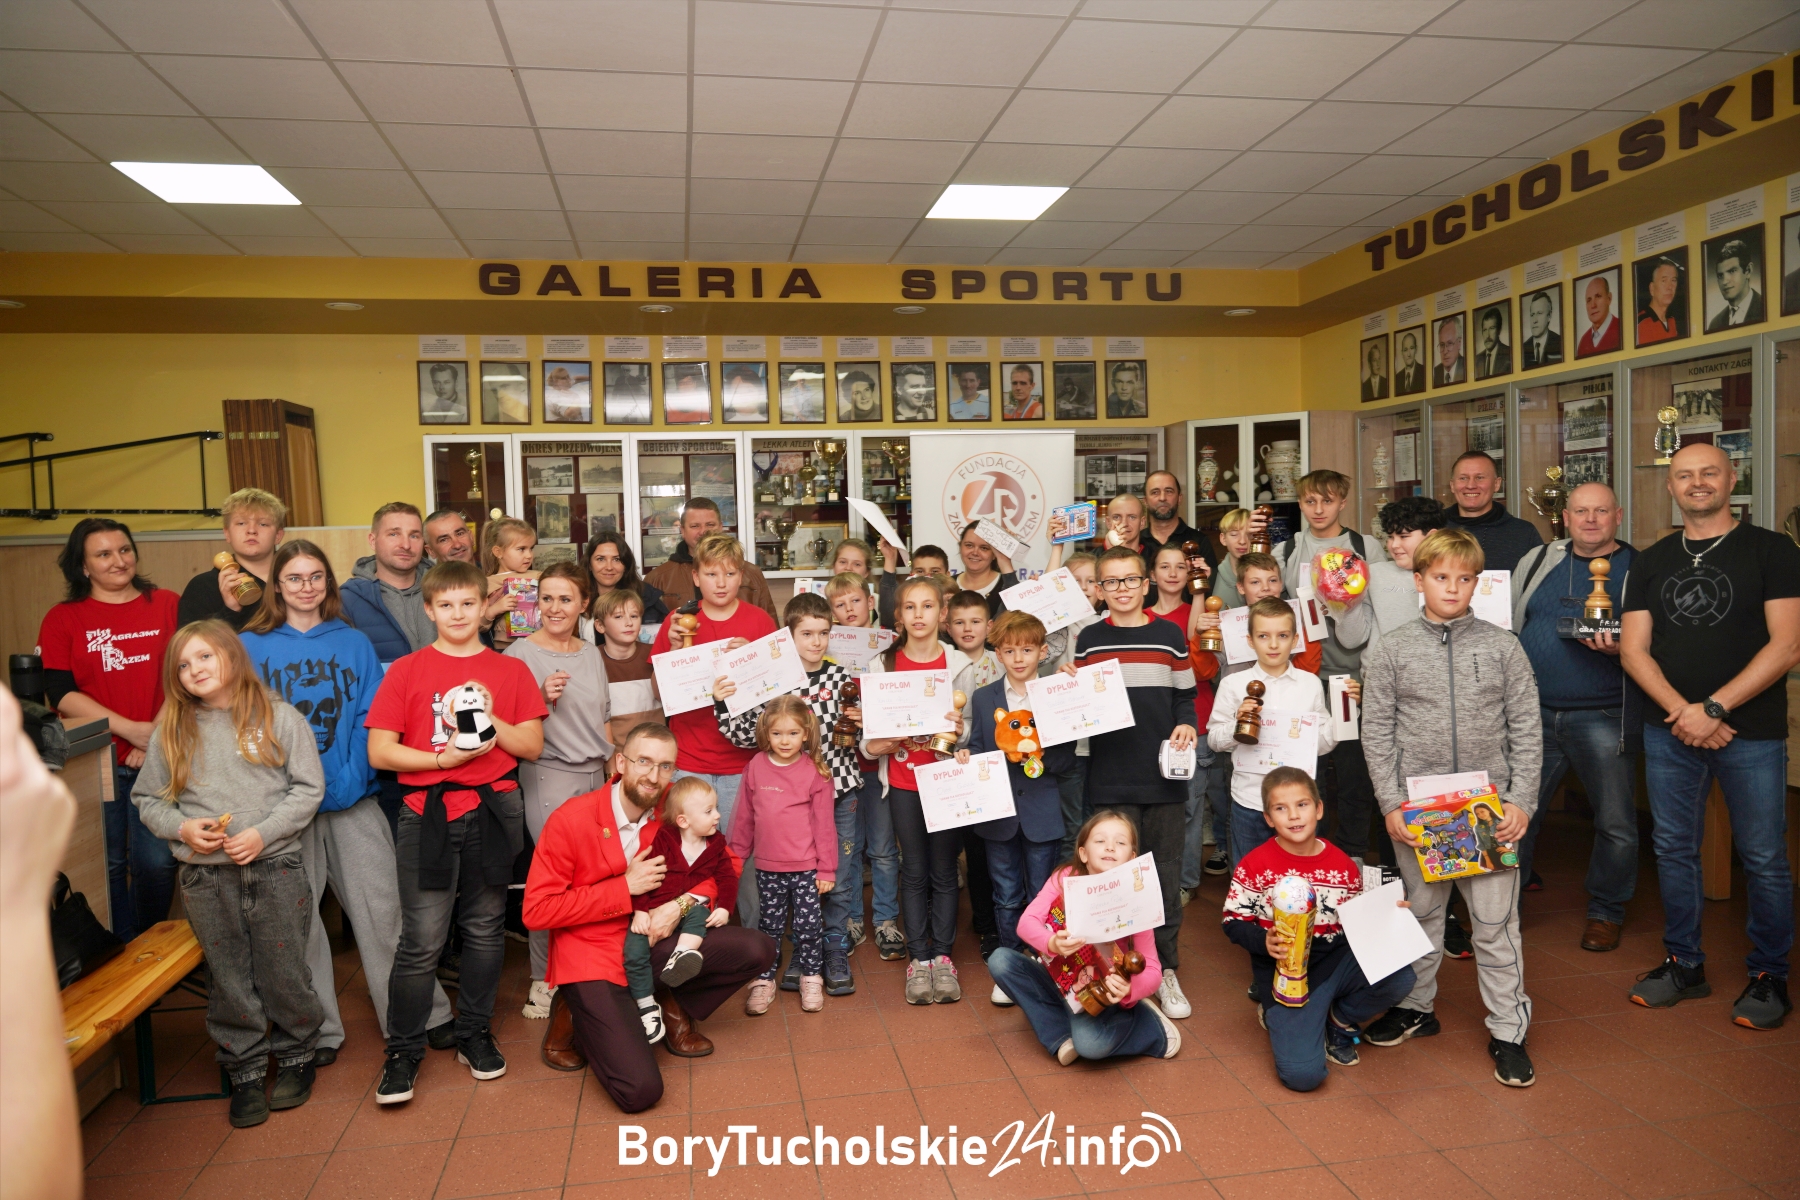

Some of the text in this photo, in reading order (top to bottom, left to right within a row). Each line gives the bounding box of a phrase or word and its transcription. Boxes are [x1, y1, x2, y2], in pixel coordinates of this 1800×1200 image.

[1364, 56, 1800, 272] TUCHOLSKI
[479, 263, 1182, 302] GALERIA SPORTU
[1688, 358, 1752, 376] KONTAKTY ZAGR
[1582, 382, 1606, 395] PIŁKA
[521, 442, 553, 454] OKRES
[643, 440, 729, 453] OBIEKTY SPORTOWE
[762, 440, 788, 449] LEKKA
[958, 456, 1027, 480] FUNDACJA
[1019, 510, 1040, 541] AZEM
[1018, 584, 1045, 600] DYPLOM
[829, 632, 857, 641] DYPLOM
[670, 655, 701, 668] DYPLOM
[729, 651, 759, 669] DYPLOM
[879, 681, 911, 690] DYPLOM
[1046, 680, 1080, 695] DYPLOM
[933, 767, 965, 781] DYPLOM
[1086, 879, 1121, 896] DYPLOM
